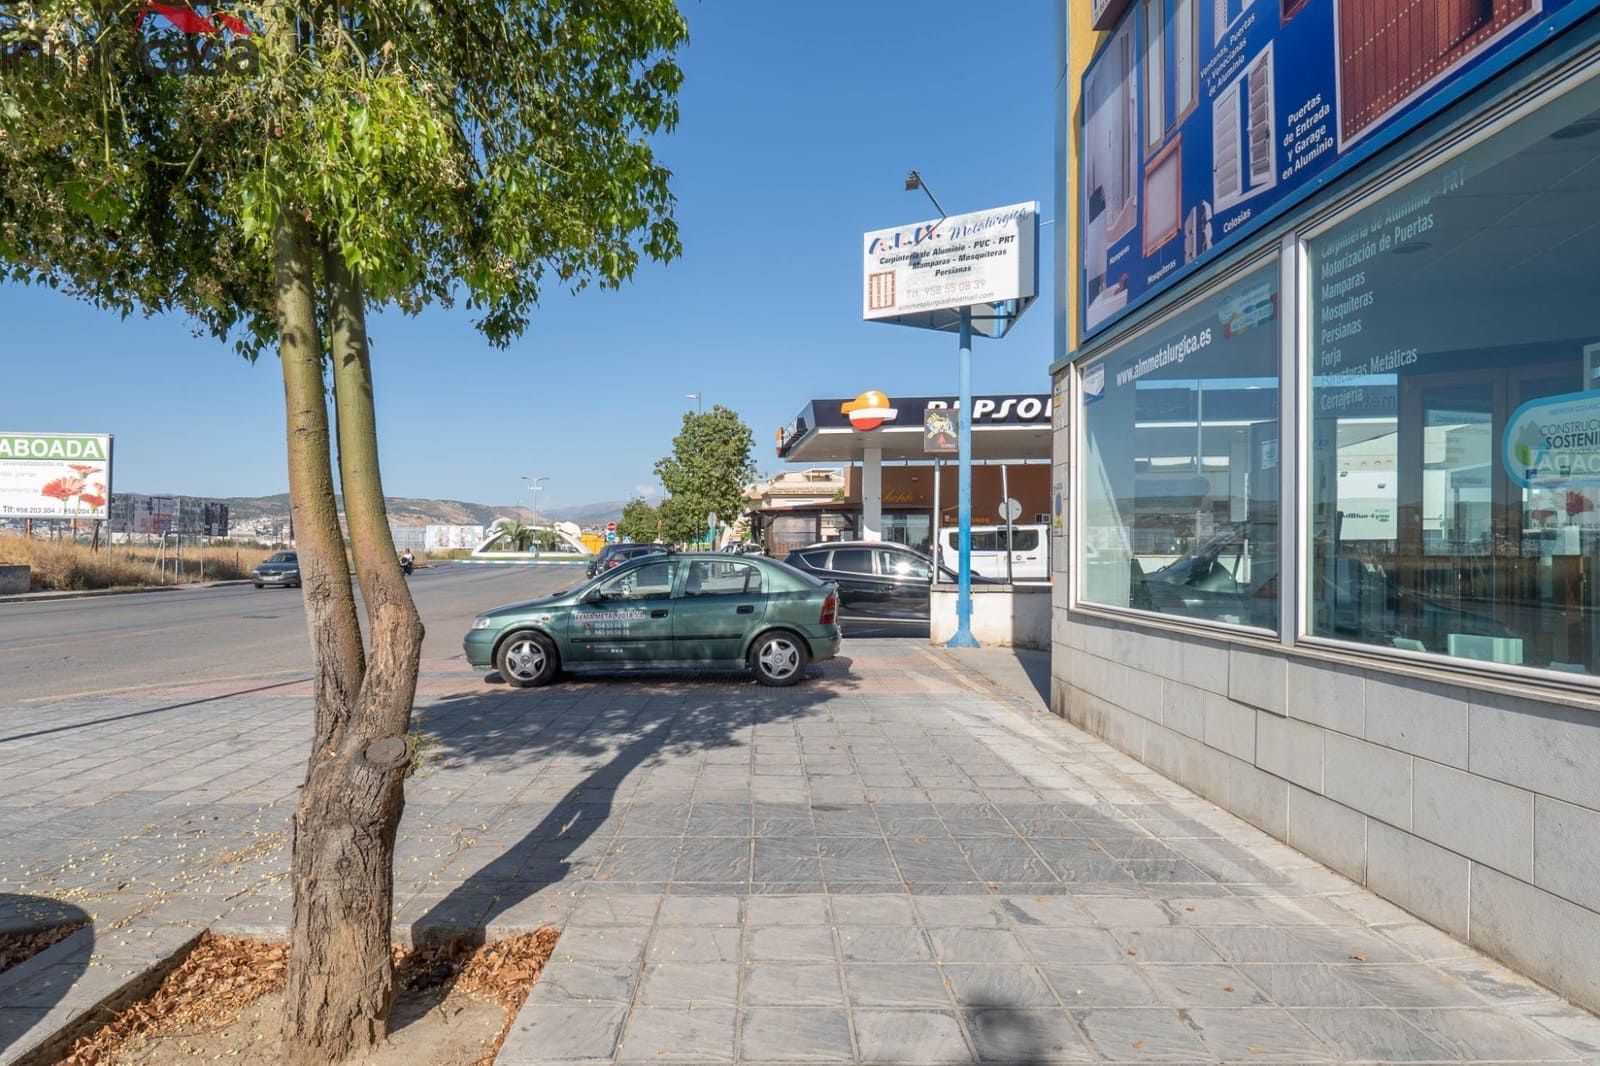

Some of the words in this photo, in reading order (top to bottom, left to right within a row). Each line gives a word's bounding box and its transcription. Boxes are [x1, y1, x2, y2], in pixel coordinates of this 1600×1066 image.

[1288, 93, 1321, 127] Puertas
[1283, 132, 1294, 147] de
[1295, 104, 1330, 137] Entrada
[1287, 149, 1293, 162] y
[1295, 124, 1327, 154] Garage
[1282, 166, 1293, 180] en
[1295, 136, 1334, 172] Aluminio
[912, 258, 950, 270] Mamparas
[958, 249, 1007, 263] Mosquiteras
[921, 250, 930, 258] de
[931, 244, 966, 257] Aluminio
[974, 239, 990, 249] PVC
[998, 235, 1016, 245] PRT
[1321, 240, 1377, 280] Motorización
[1379, 232, 1391, 253] de
[1394, 213, 1434, 245] Puertas
[934, 265, 972, 277] Persianas
[1321, 271, 1366, 301] Mamparas
[1321, 291, 1374, 323] Mosquiteras
[1321, 319, 1362, 345] Persianas
[1321, 348, 1342, 367] Forja
[1370, 348, 1418, 373] Metálicas
[1546, 431, 1600, 450] SOSTENI
